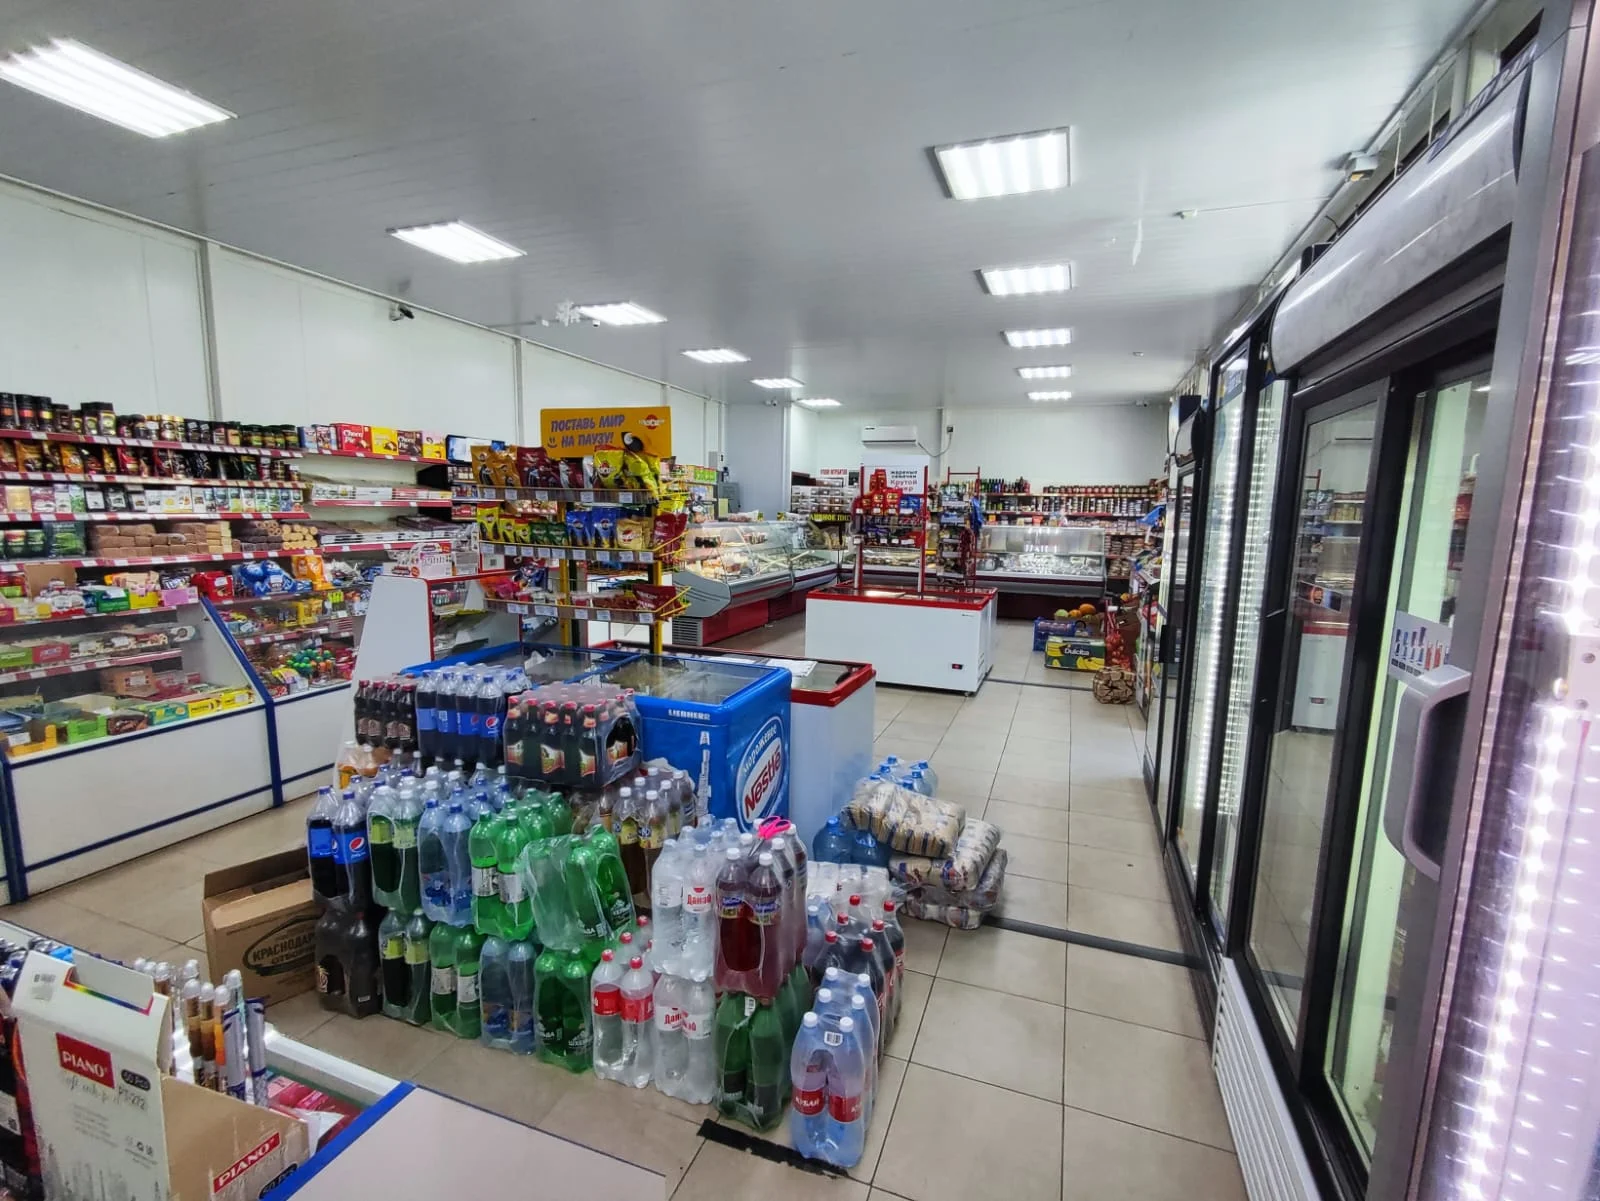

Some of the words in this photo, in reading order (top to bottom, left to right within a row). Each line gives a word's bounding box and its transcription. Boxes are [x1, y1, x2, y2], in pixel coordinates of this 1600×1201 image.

[551, 418, 595, 432] ПОСТАВЬ
[599, 415, 625, 428] МИР
[561, 435, 575, 448] НА
[578, 432, 614, 446] ПАУЗУ!
[219, 1143, 270, 1186] PIANO
